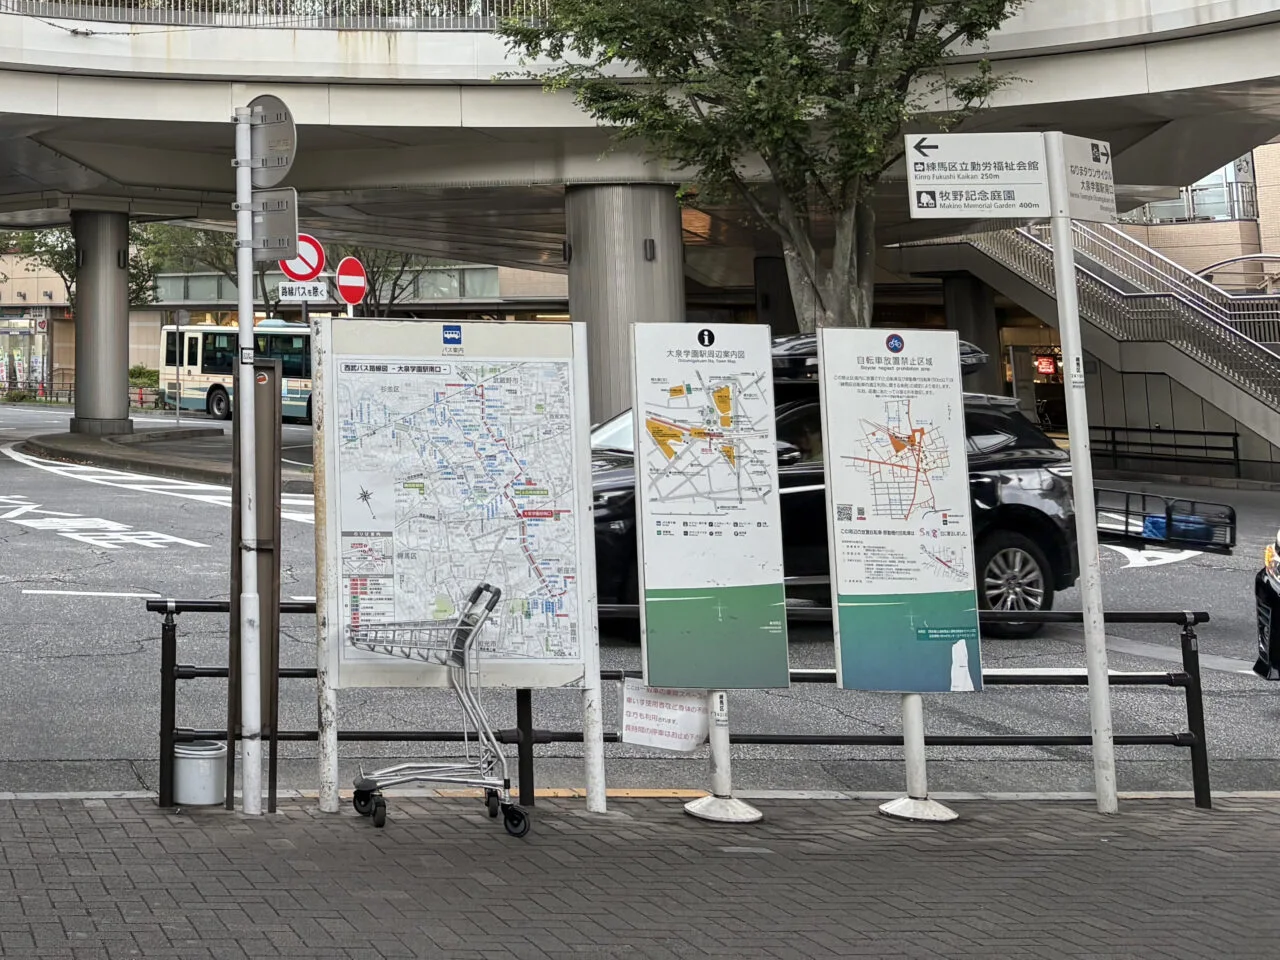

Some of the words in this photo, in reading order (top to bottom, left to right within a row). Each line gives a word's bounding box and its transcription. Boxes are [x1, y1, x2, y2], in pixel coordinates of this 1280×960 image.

[926, 160, 1039, 172] 練馬区立勤労福祉会館
[939, 190, 1015, 201] 牧野記念庭園
[281, 285, 324, 298] 路線バスを除く
[857, 356, 934, 366] 自転車放置禁止区域
[344, 364, 388, 372] 西武バス路線図
